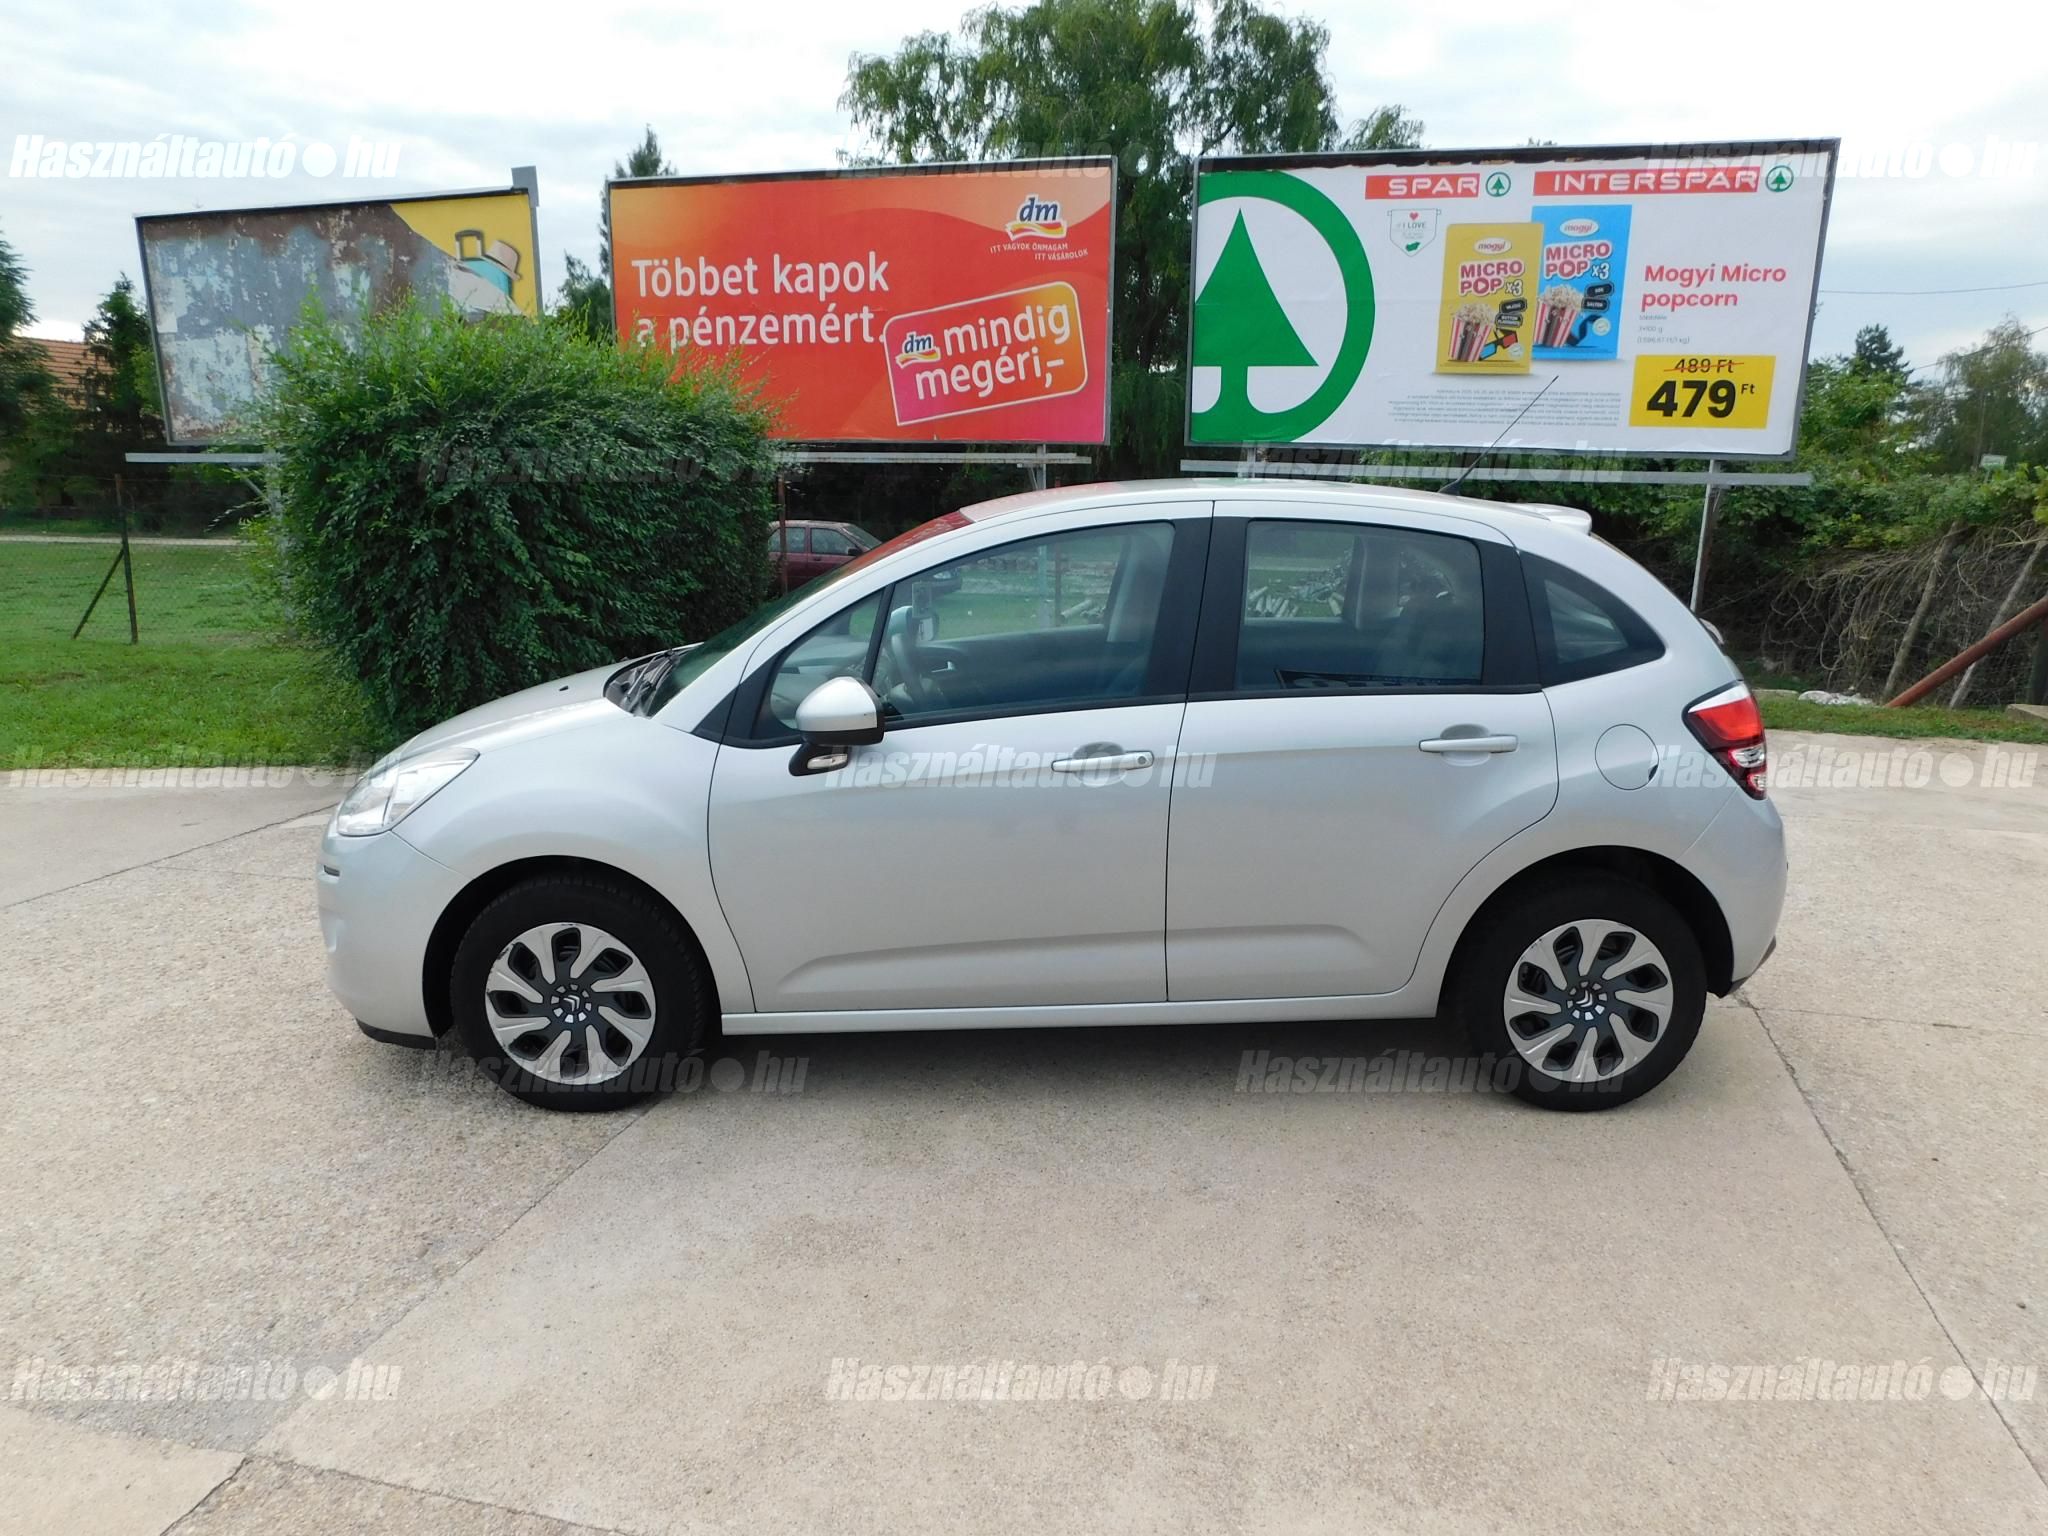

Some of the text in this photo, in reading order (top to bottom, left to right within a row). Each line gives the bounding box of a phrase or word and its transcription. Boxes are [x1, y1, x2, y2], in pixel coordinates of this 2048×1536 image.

[1388, 177, 1478, 195] SPAR
[1554, 170, 1757, 192] INTERSPAR
[1019, 196, 1059, 222] dm
[990, 244, 1001, 254] ITT
[1035, 252, 1046, 261] ITT
[1545, 242, 1611, 261] MICRO
[631, 250, 889, 302] Többet kapok
[1460, 260, 1523, 279] MICRO
[1545, 260, 1589, 278] POP
[1644, 263, 1787, 288] Mogyi Micro
[1460, 277, 1503, 295] POP
[1641, 293, 1738, 312] popcorn
[637, 303, 885, 354] a pénzemért.
[904, 304, 1071, 356] dm mindig
[1674, 358, 1734, 373] 489 Ft
[1647, 379, 1755, 418] 479 Ft
